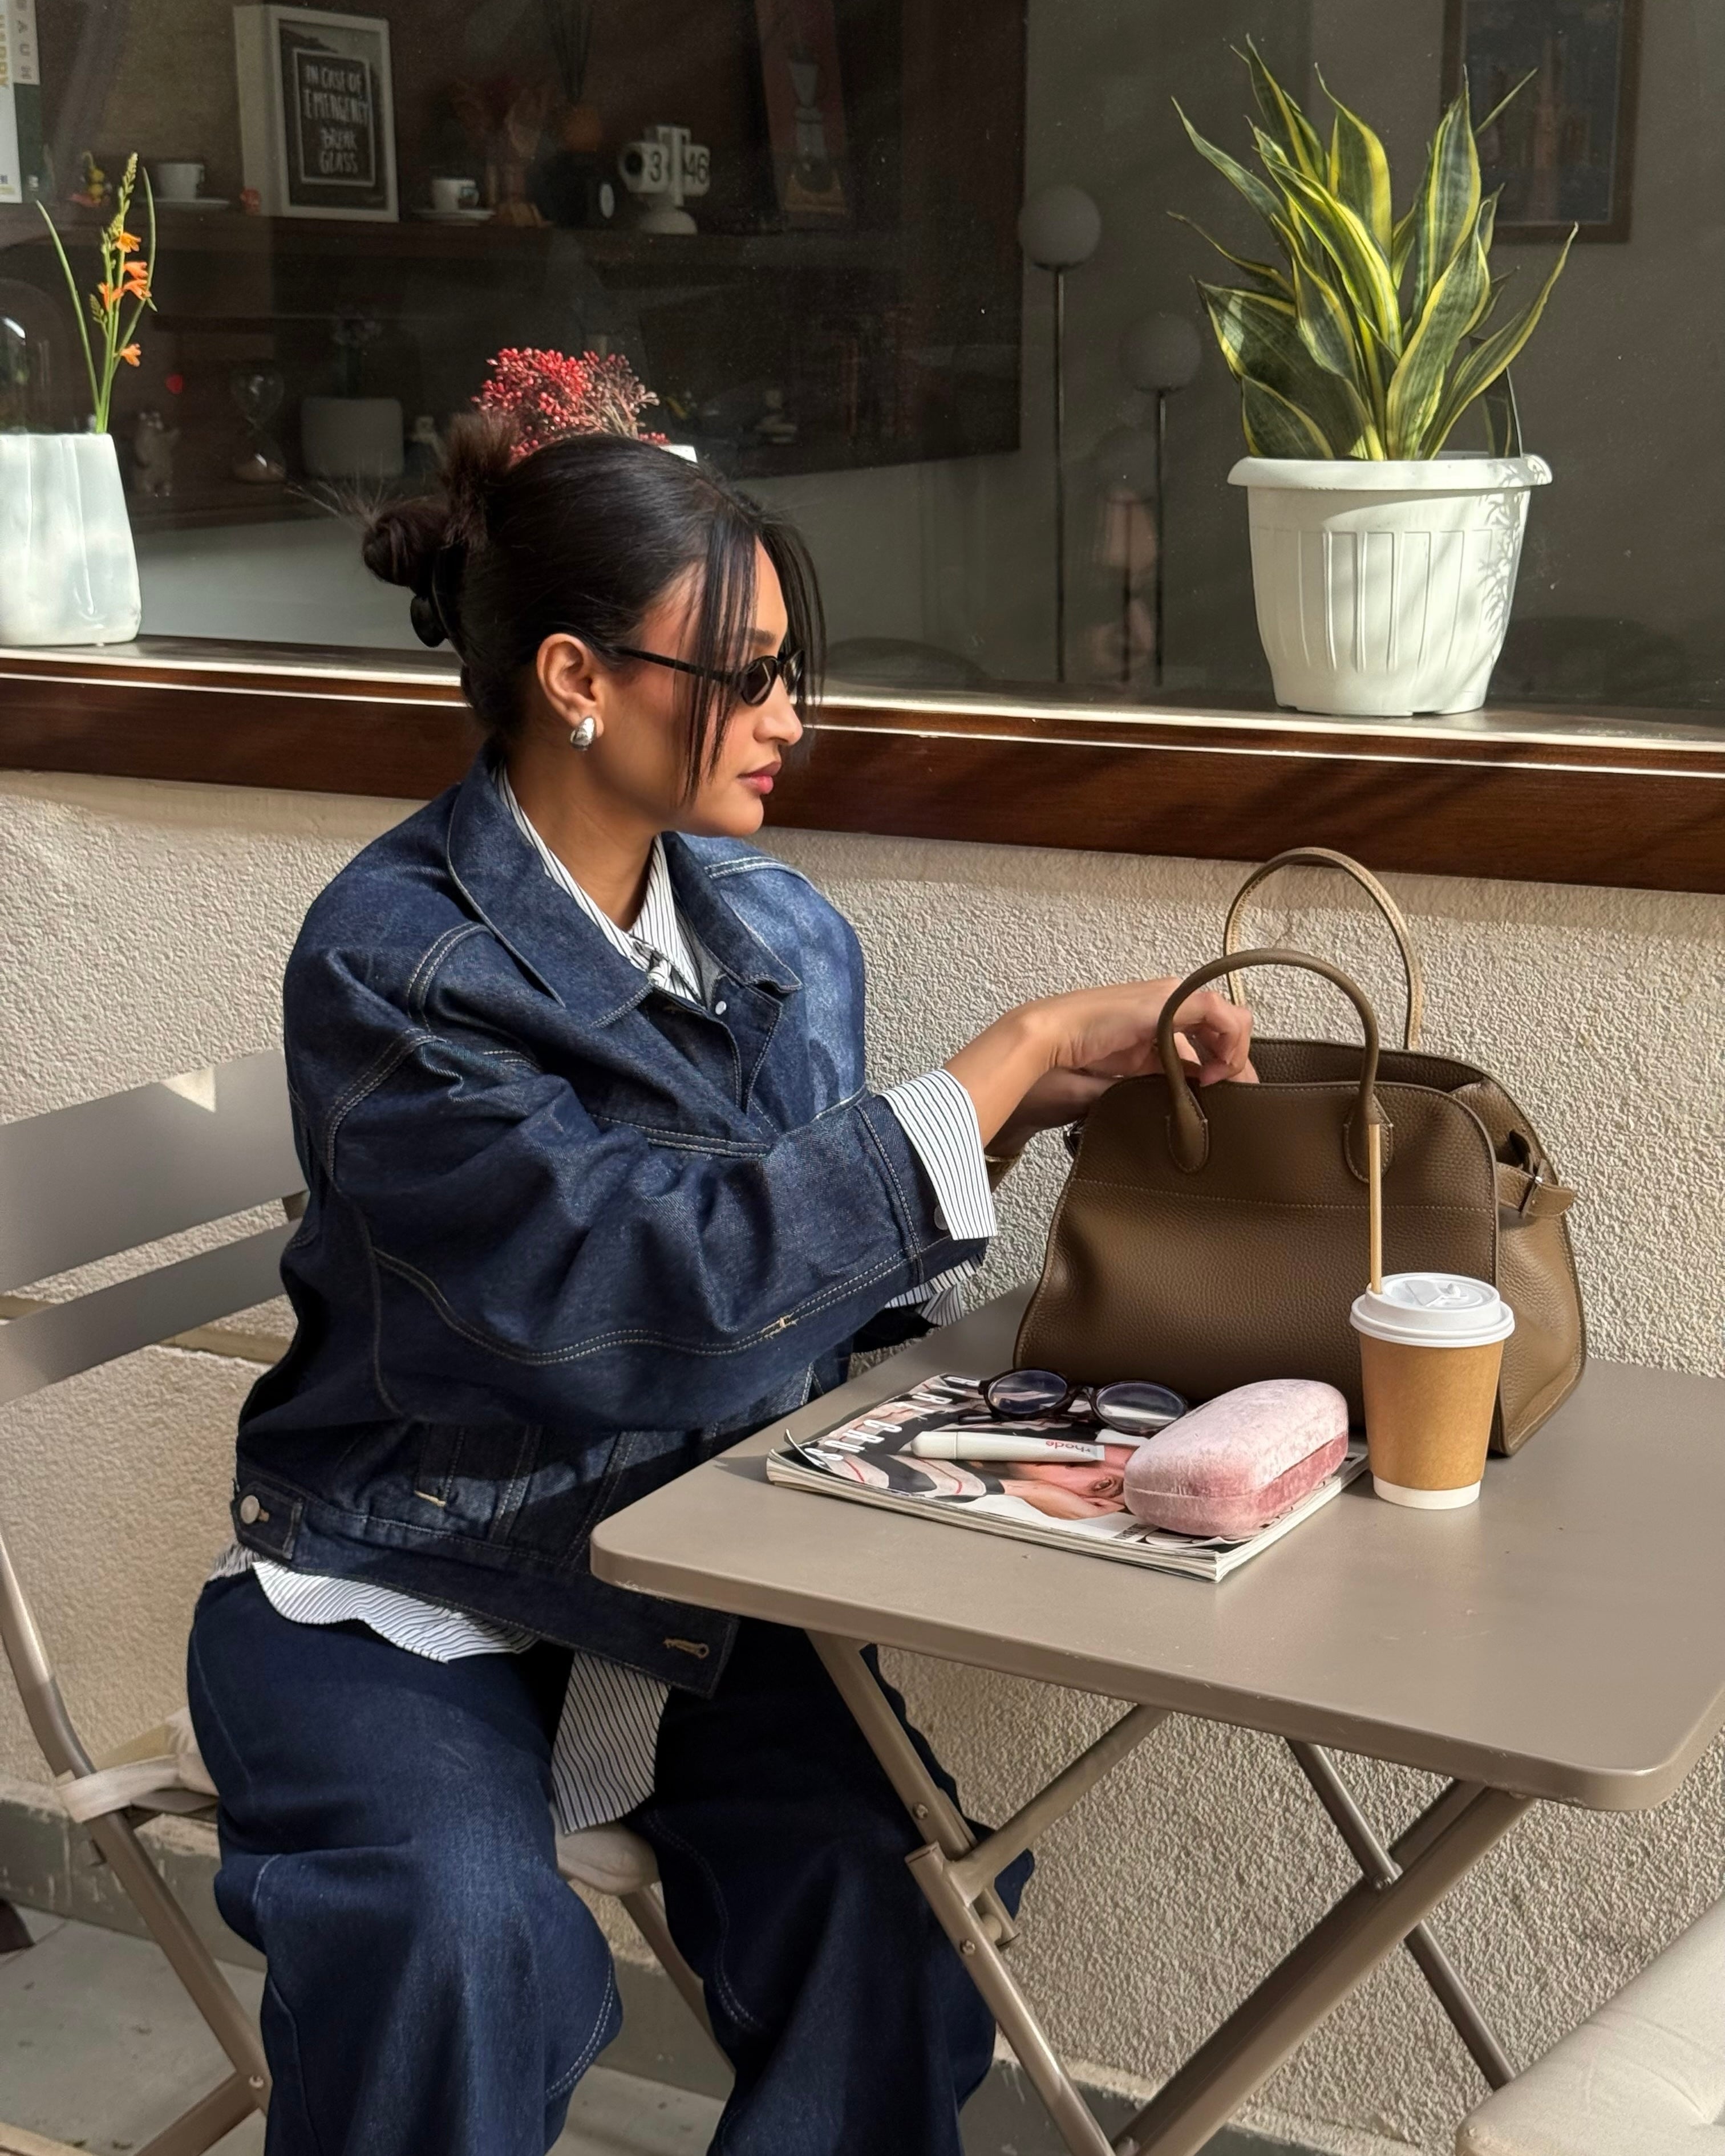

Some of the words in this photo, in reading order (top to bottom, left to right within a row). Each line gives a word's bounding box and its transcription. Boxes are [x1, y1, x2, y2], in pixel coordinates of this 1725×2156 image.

[305, 64, 318, 84] IN
[321, 67, 346, 92] CASE
[303, 88, 369, 126] EMERGENCY
[320, 127, 358, 151] BREAK
[319, 150, 358, 175] GLASS
[894, 1376, 982, 1415] GIRL
[1045, 1440, 1091, 1453] rhode
